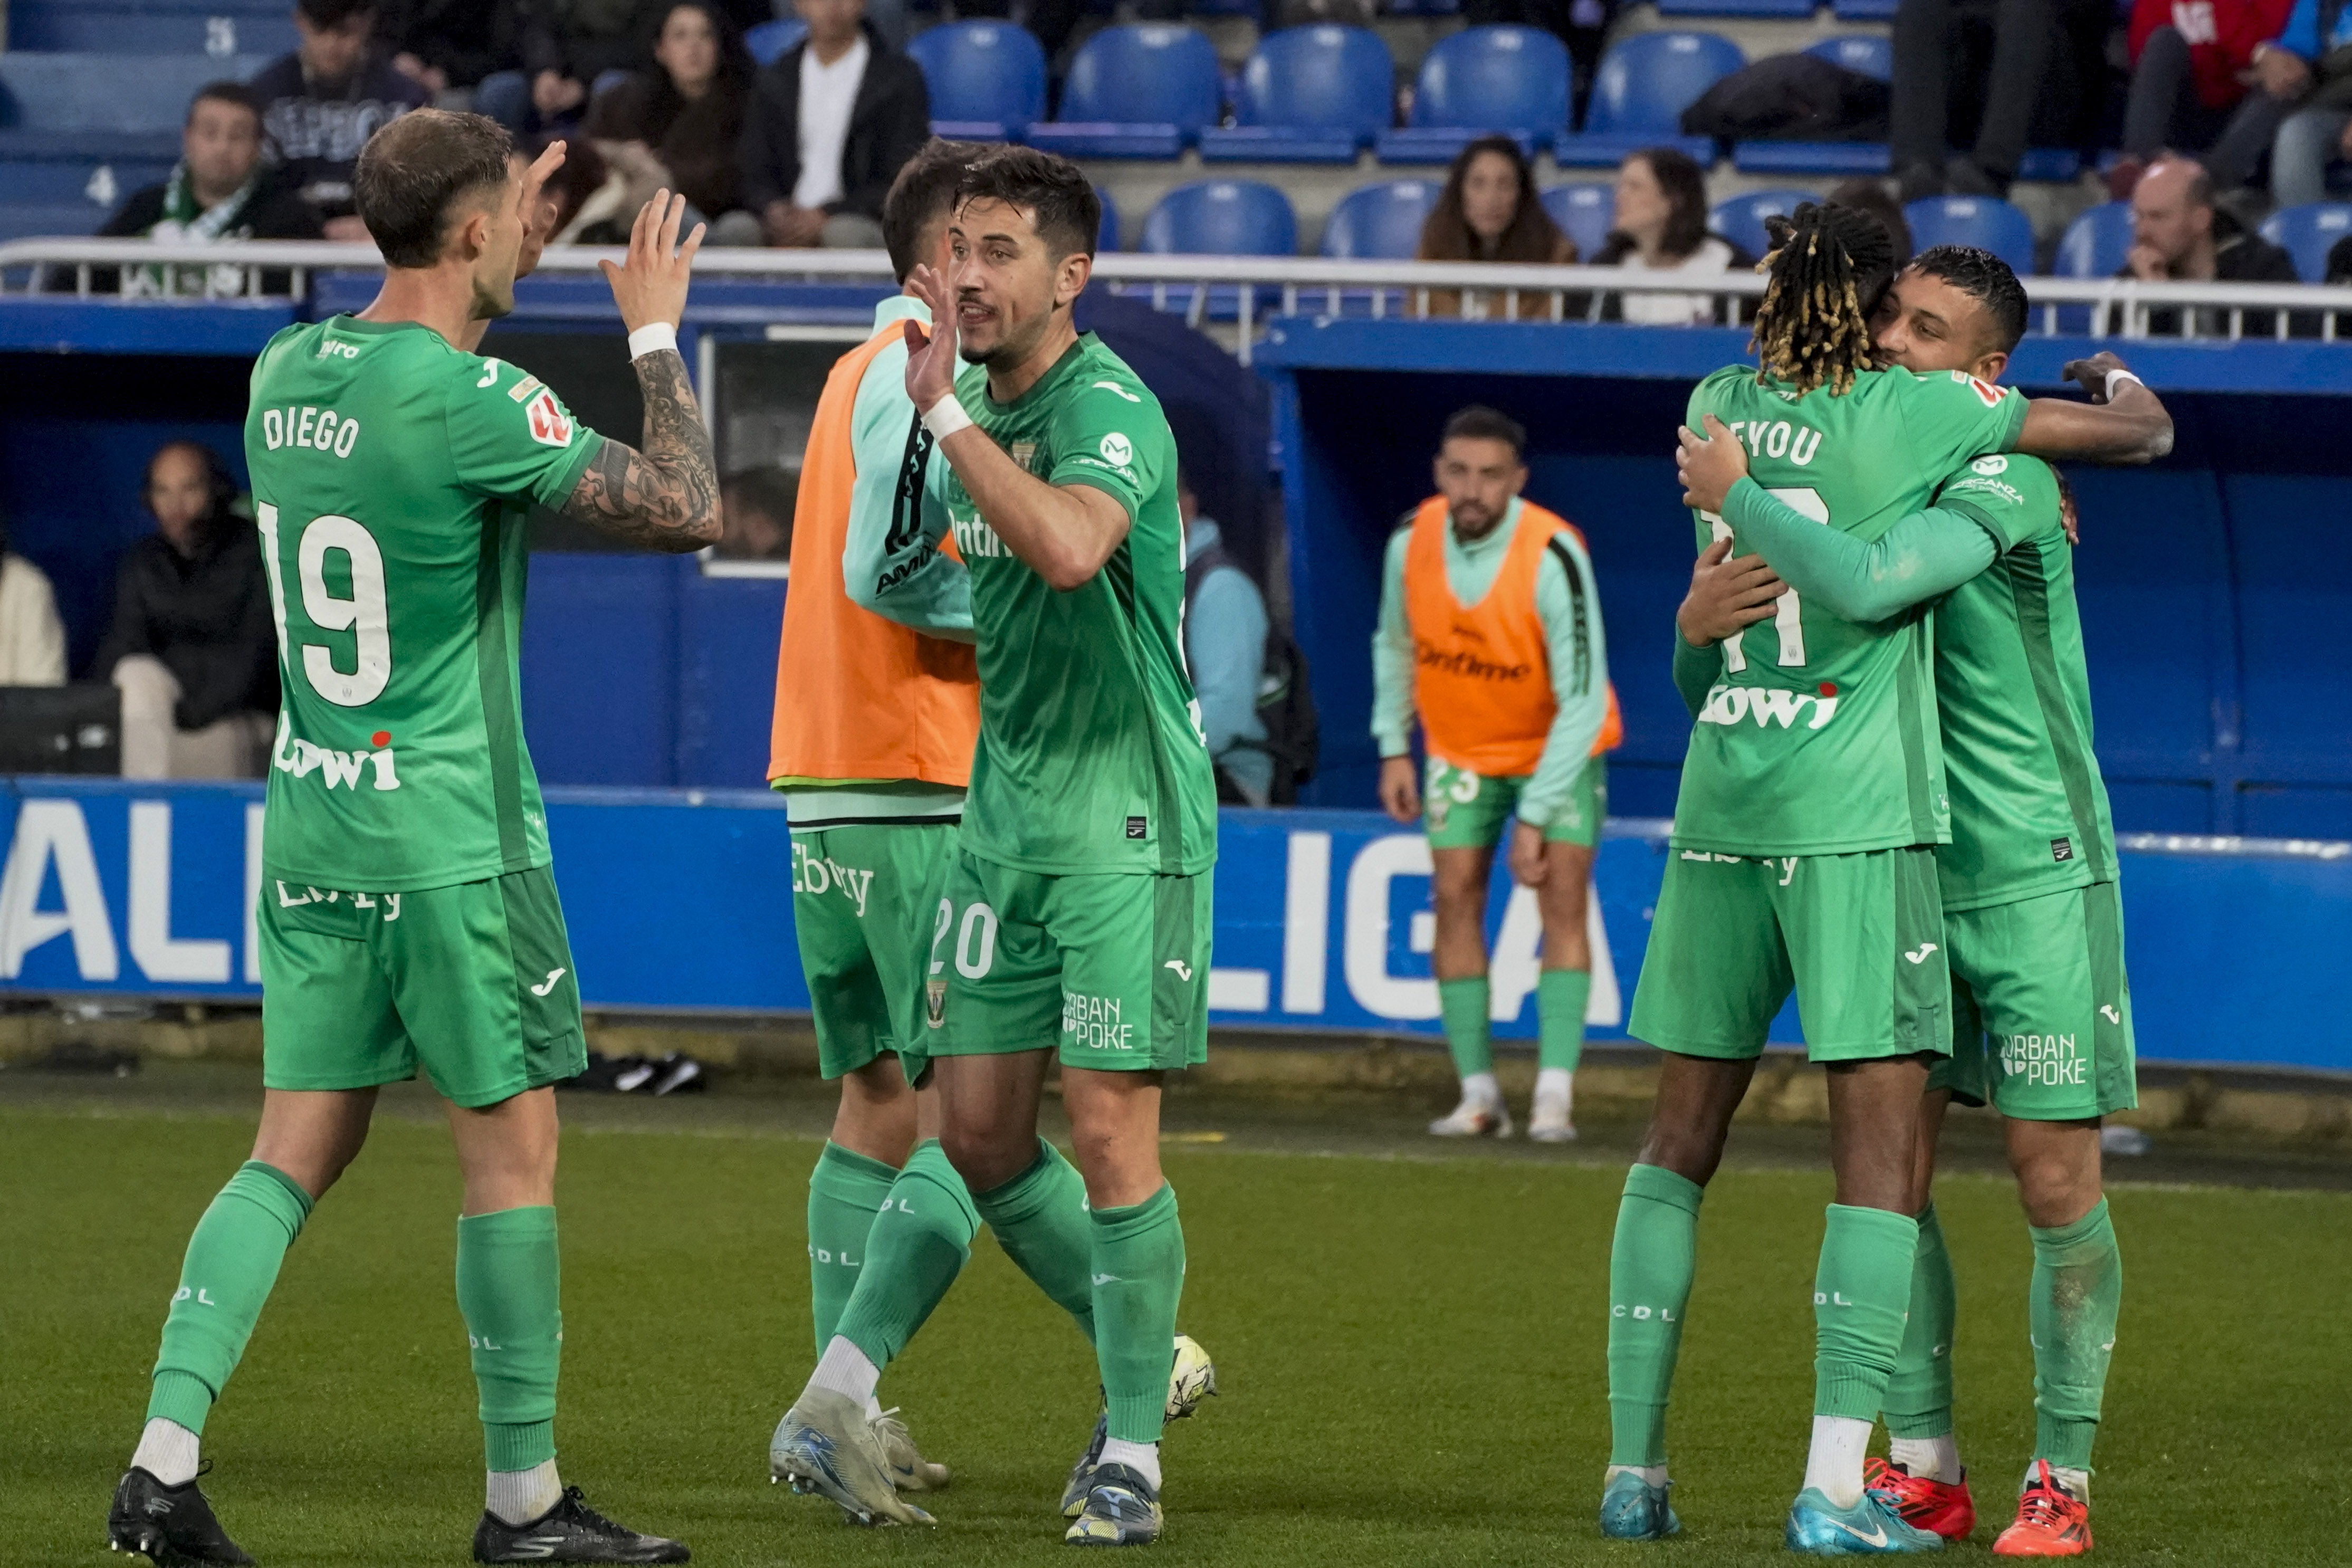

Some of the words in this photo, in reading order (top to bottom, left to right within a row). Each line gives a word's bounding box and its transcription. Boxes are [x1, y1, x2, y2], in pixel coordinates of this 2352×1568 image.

[264, 406, 359, 458] DIEGO
[257, 500, 393, 707] 19
[929, 898, 998, 979] 20
[1076, 1020, 1133, 1049] POKE
[2028, 1058, 2087, 1086] POKE
[1613, 1304, 1676, 1322] CDL
